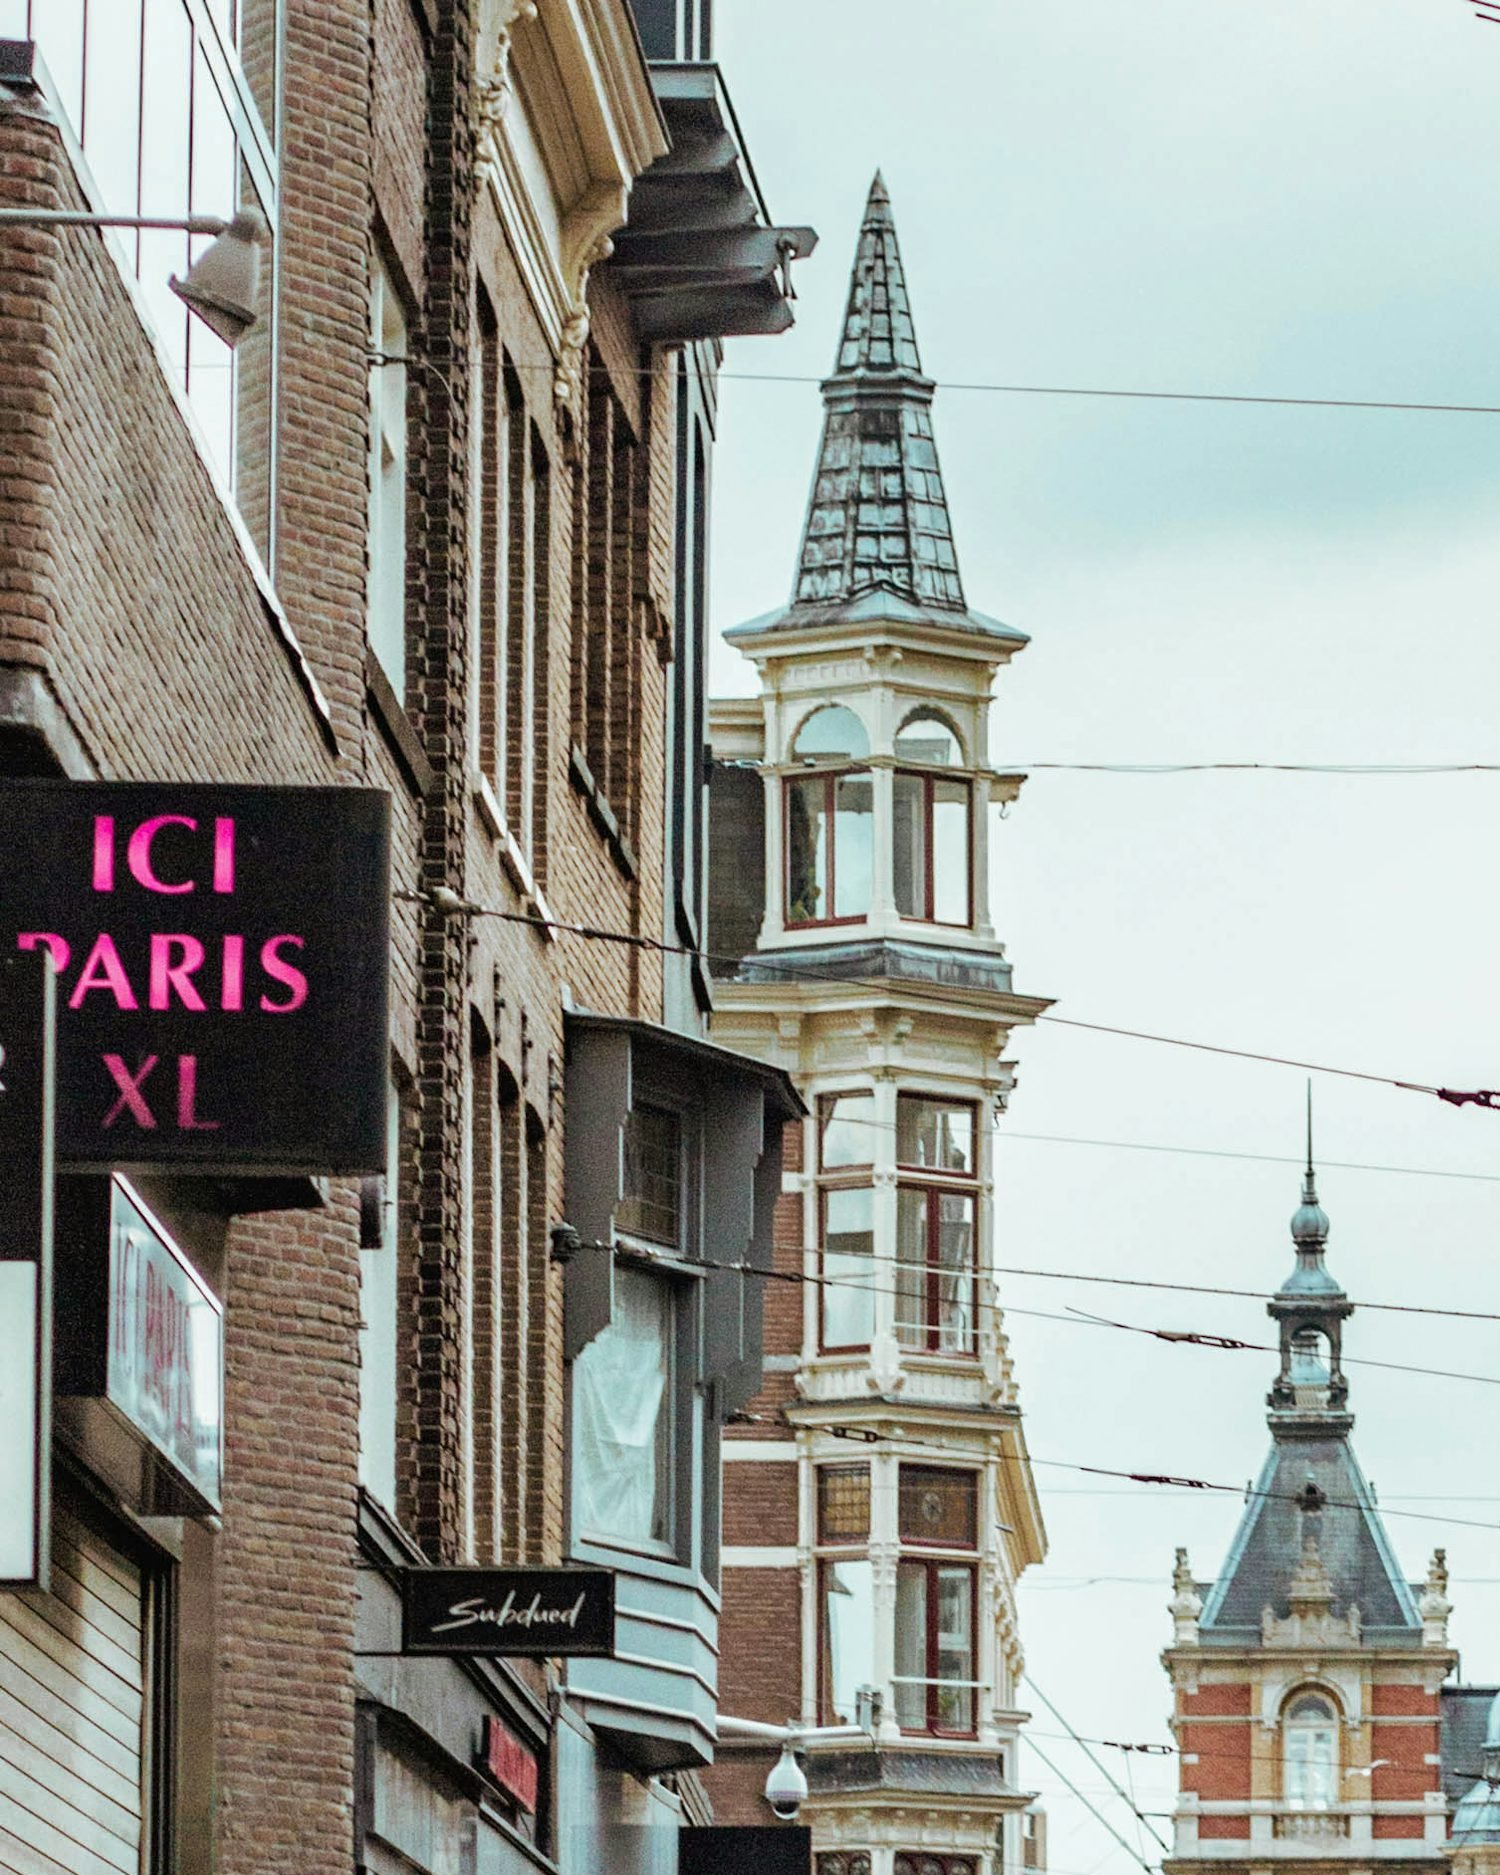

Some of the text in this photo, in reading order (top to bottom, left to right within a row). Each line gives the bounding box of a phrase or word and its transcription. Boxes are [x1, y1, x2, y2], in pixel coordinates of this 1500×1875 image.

[92, 814, 236, 895] ICI
[101, 1053, 222, 1130] XL
[431, 1589, 586, 1632] Subdued
